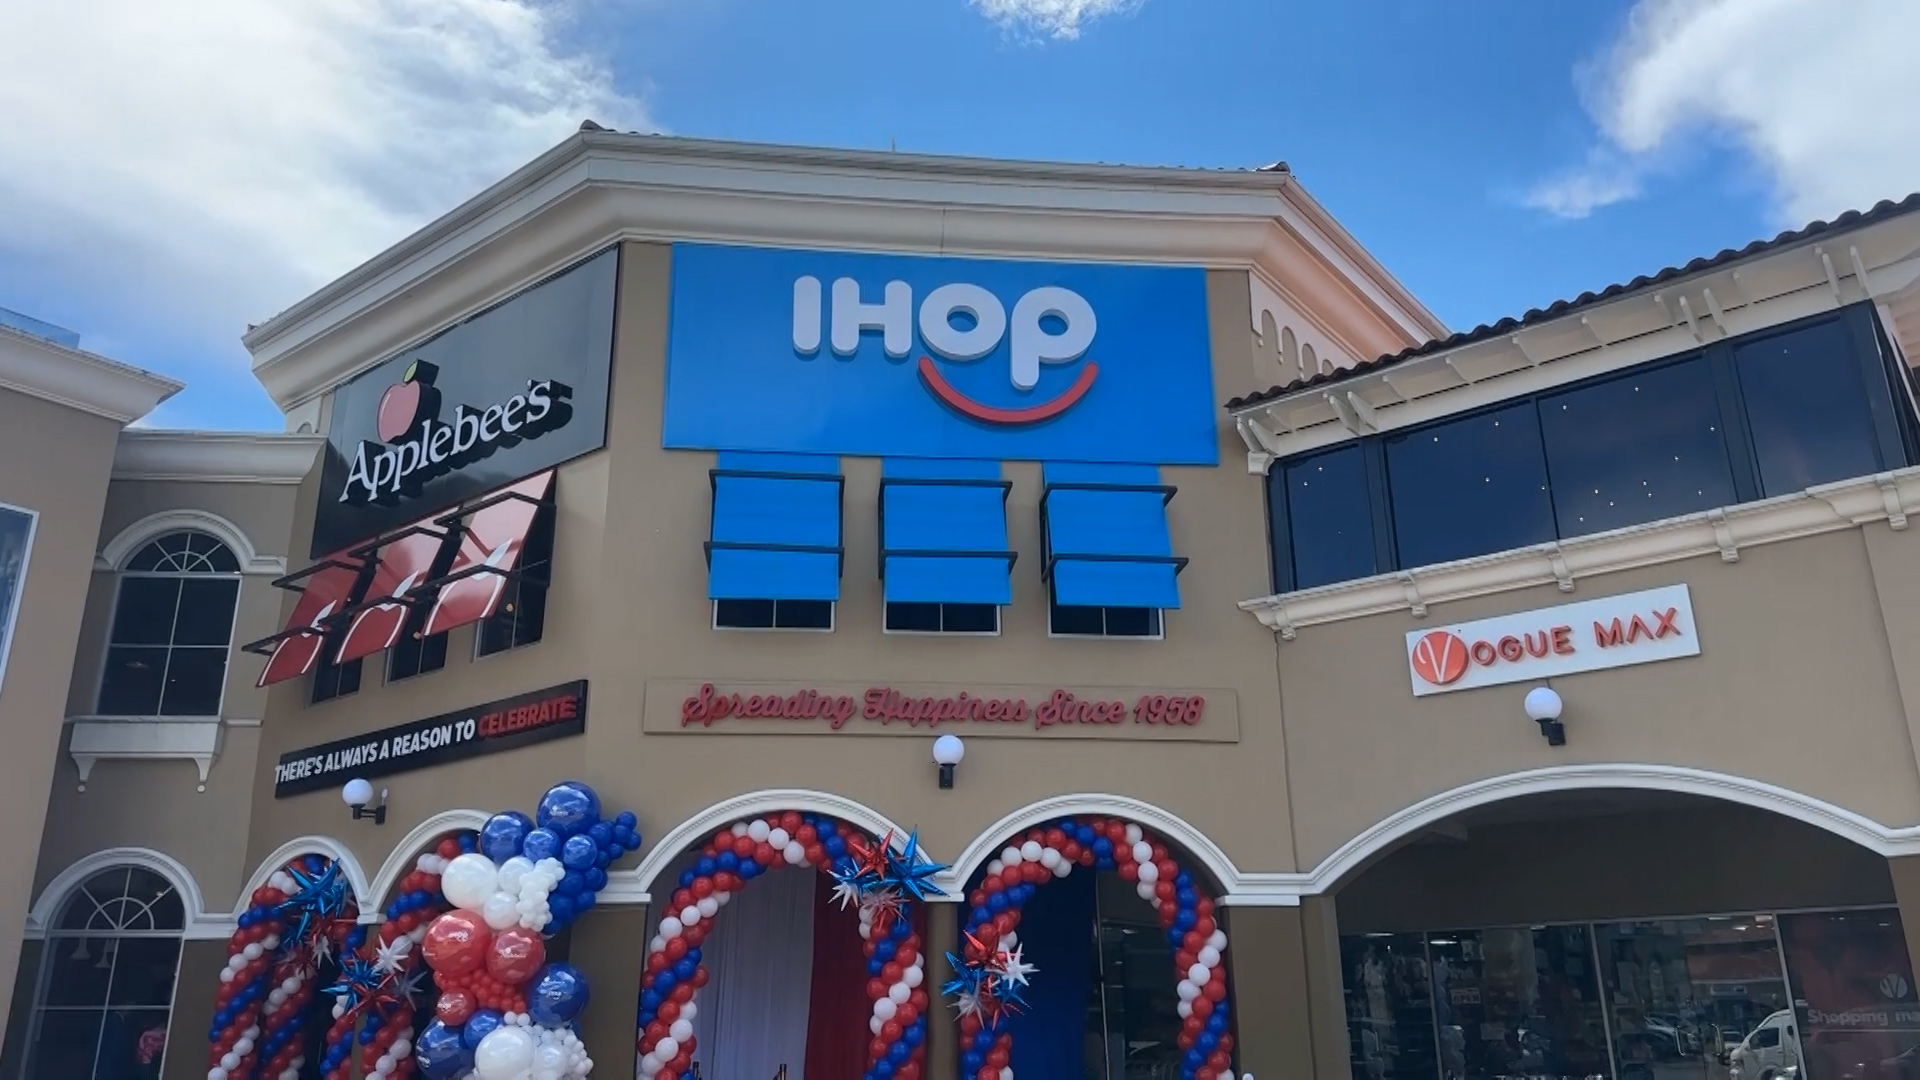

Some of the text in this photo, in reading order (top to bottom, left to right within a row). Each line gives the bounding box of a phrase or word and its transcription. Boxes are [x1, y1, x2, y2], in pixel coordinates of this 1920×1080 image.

[793, 275, 1097, 391] IHOP
[339, 379, 553, 503] Applebee's
[1413, 607, 1681, 685] VOGUE MAX
[274, 695, 577, 784] THERE'S ALWAYS A REASON TO CELEBRATE
[682, 683, 1205, 731] Spreading Happiness Since 1958
[1807, 1009, 1889, 1027] Shopping
